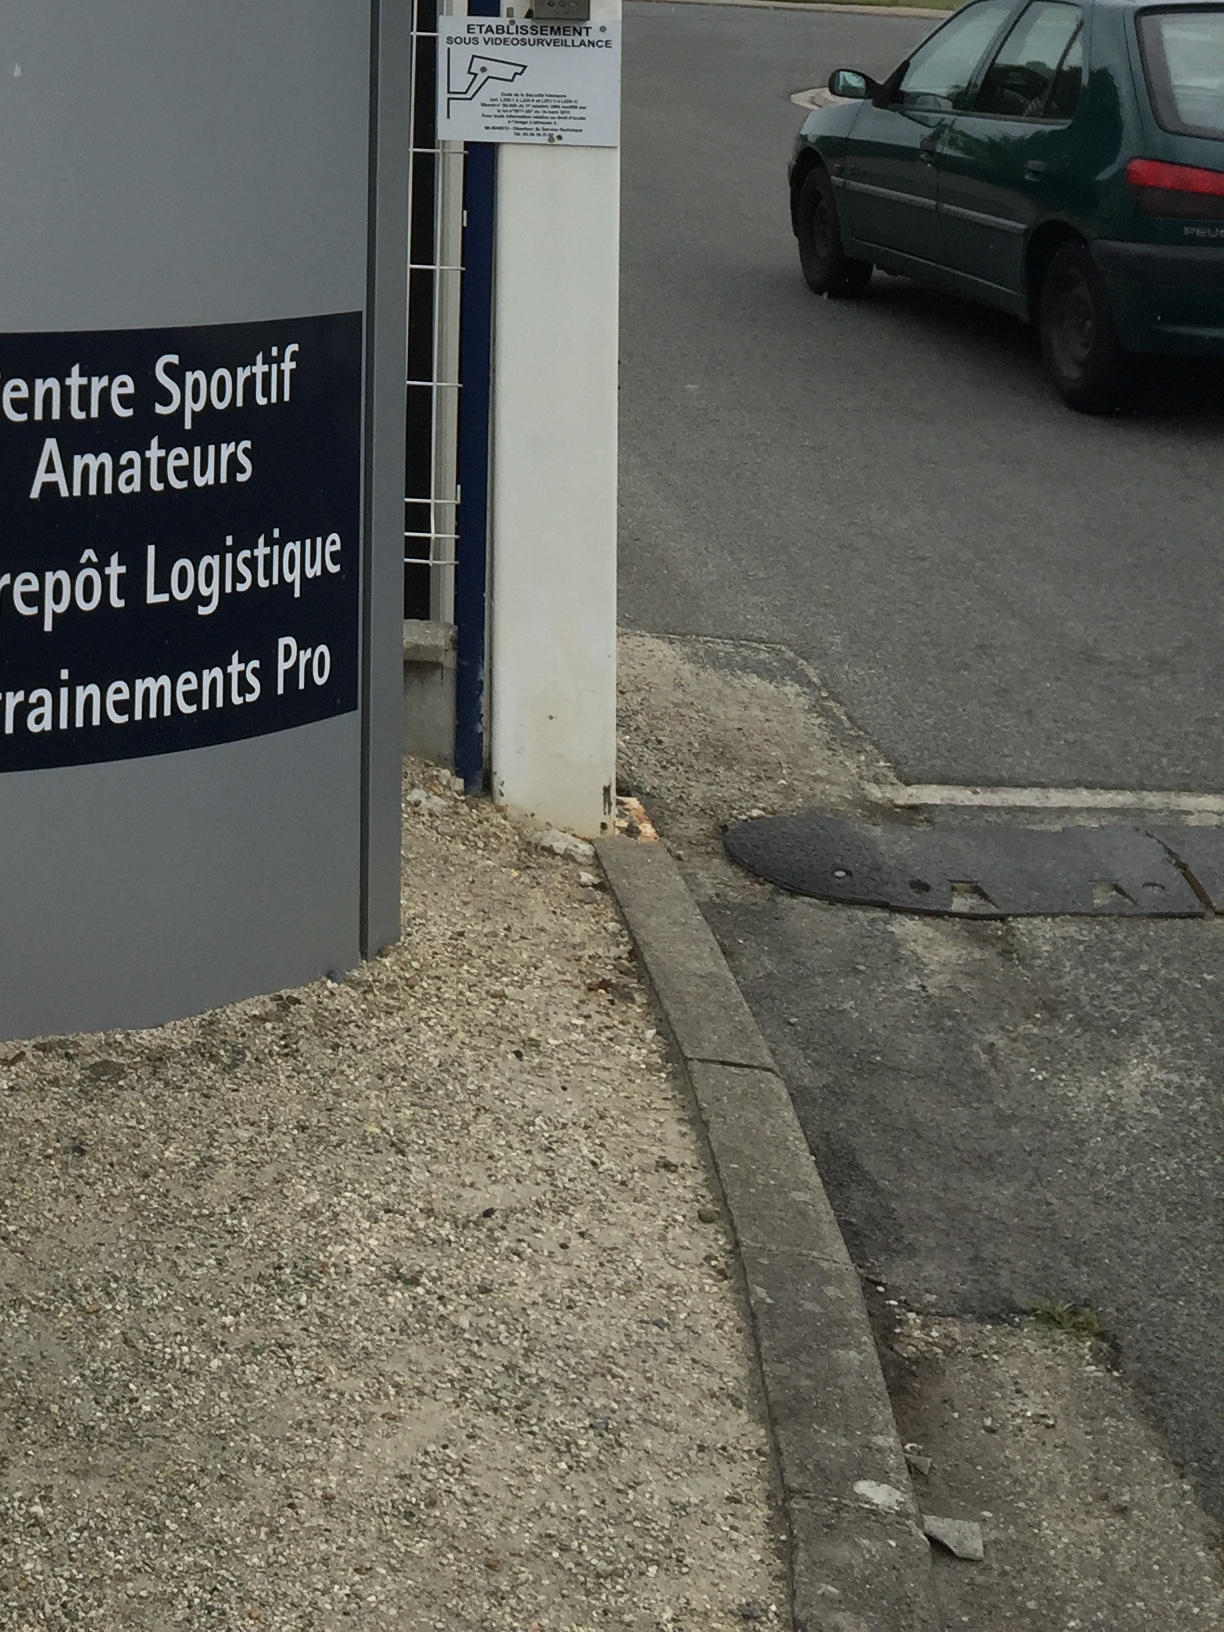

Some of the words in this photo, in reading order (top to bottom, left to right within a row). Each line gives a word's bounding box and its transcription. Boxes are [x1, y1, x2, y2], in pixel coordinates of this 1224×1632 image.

[445, 35, 480, 46] SOUS
[482, 36, 613, 48] VIDEOSURVEILLANCE
[466, 24, 593, 37] ETABLISSEMENT
[154, 343, 299, 430] Sportif
[29, 435, 253, 500] Amateurs
[146, 527, 342, 616] Logistique
[277, 636, 331, 695] Pro
